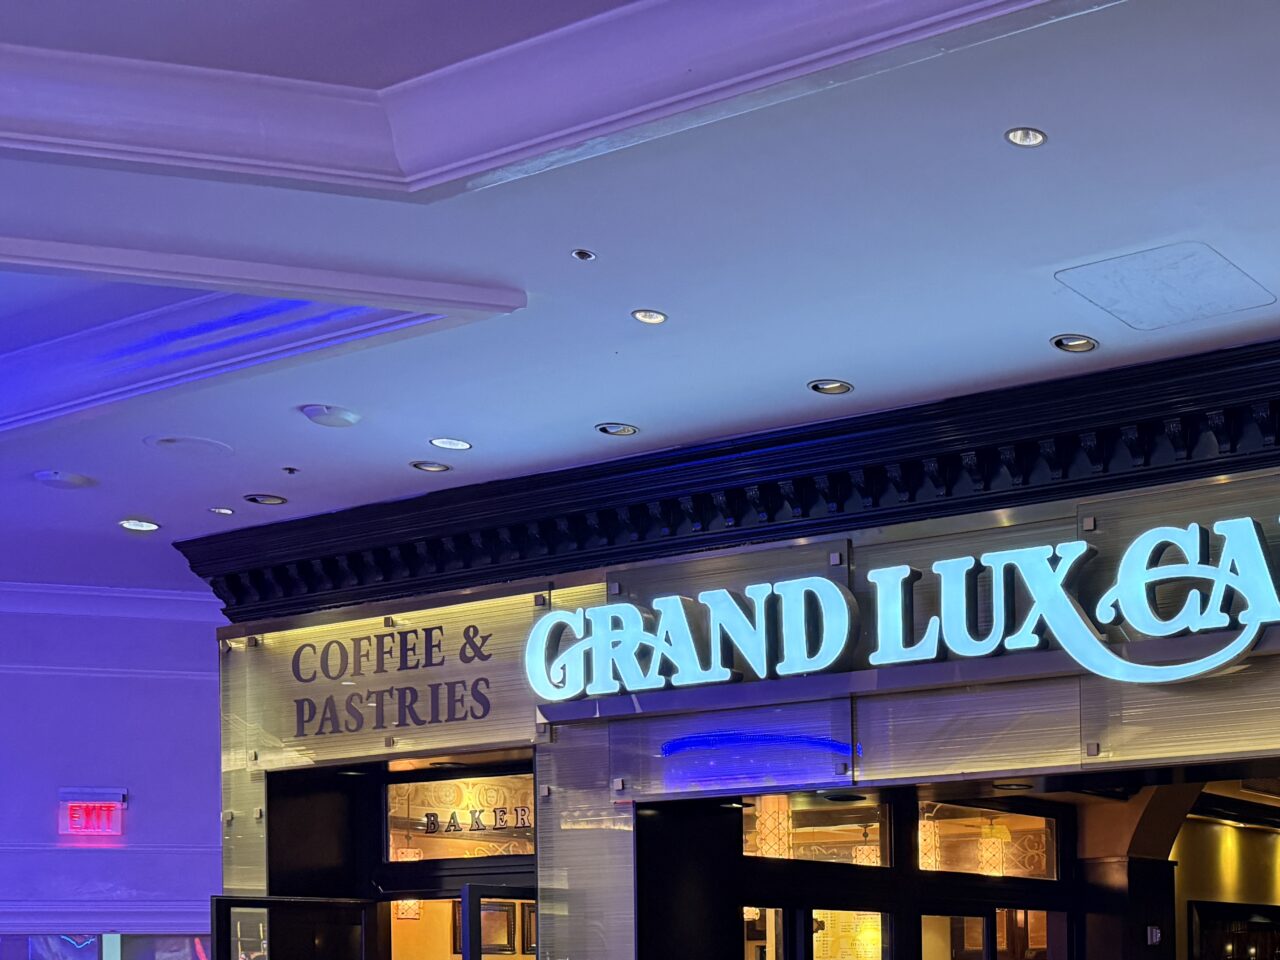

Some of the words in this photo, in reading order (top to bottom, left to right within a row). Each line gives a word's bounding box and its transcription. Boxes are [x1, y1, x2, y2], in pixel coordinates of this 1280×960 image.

[525, 576, 849, 700] GRAND
[867, 540, 1160, 683] LUX
[291, 625, 445, 684] COFFEE
[459, 624, 493, 664] &
[293, 677, 492, 738] PASTRIES
[69, 803, 115, 832] EXIT
[425, 806, 531, 834] BAKER
